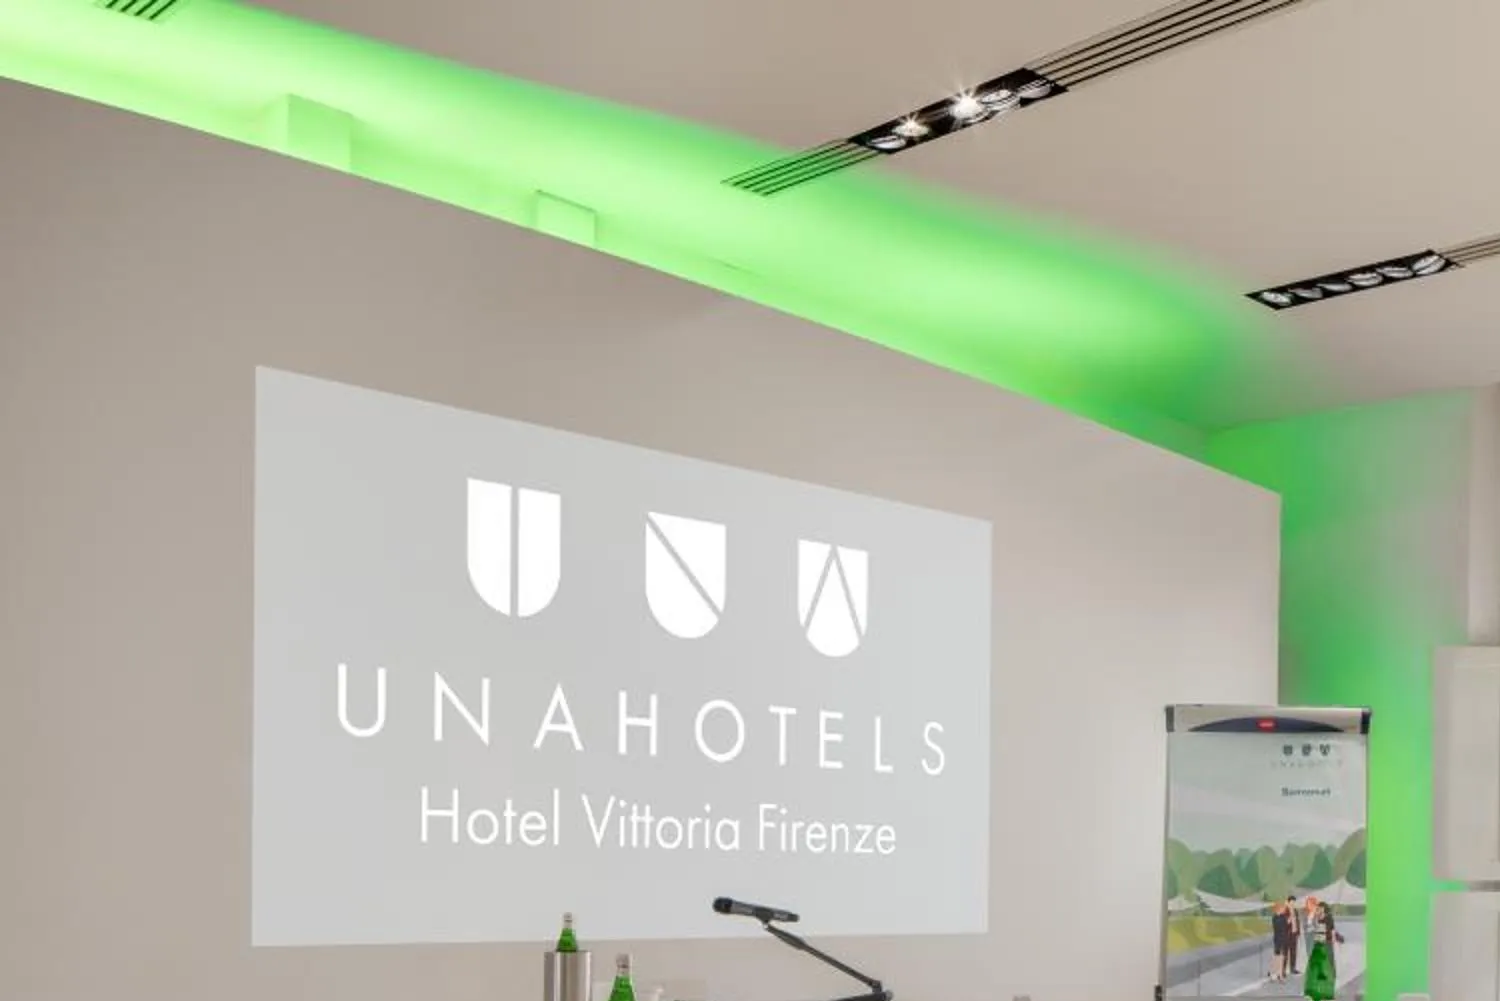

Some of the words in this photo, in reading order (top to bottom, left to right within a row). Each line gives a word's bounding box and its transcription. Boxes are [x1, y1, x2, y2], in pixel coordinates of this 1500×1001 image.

[336, 662, 946, 776] UNAHOTELS
[420, 786, 560, 846] Hotel
[581, 794, 741, 851] Vittoria
[758, 802, 897, 855] Firenze
